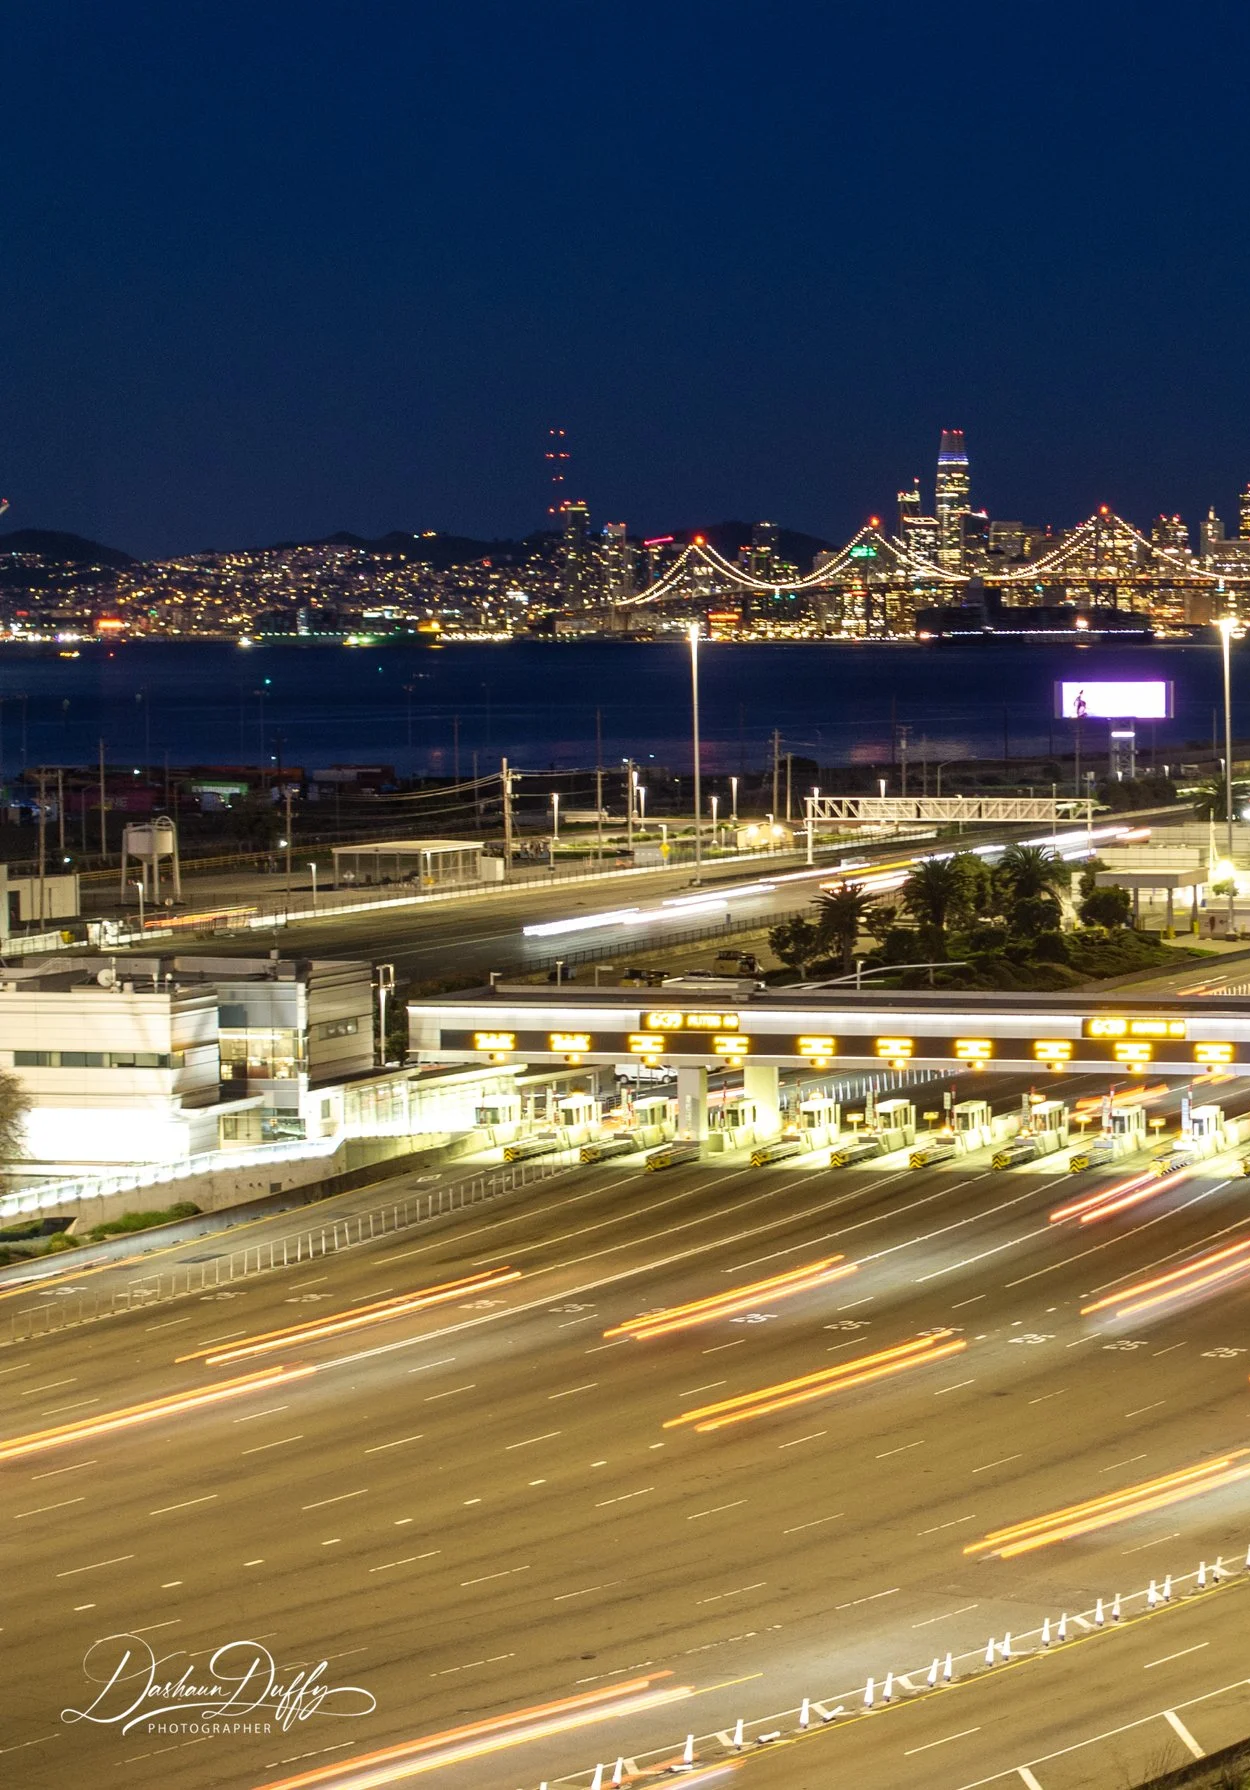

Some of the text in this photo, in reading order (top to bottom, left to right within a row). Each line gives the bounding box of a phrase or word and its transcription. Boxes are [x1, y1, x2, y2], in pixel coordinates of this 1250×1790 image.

[729, 1313, 779, 1324] 25
[1007, 1333, 1056, 1344] 25
[1102, 1340, 1149, 1351] 25
[1200, 1347, 1248, 1358] 25
